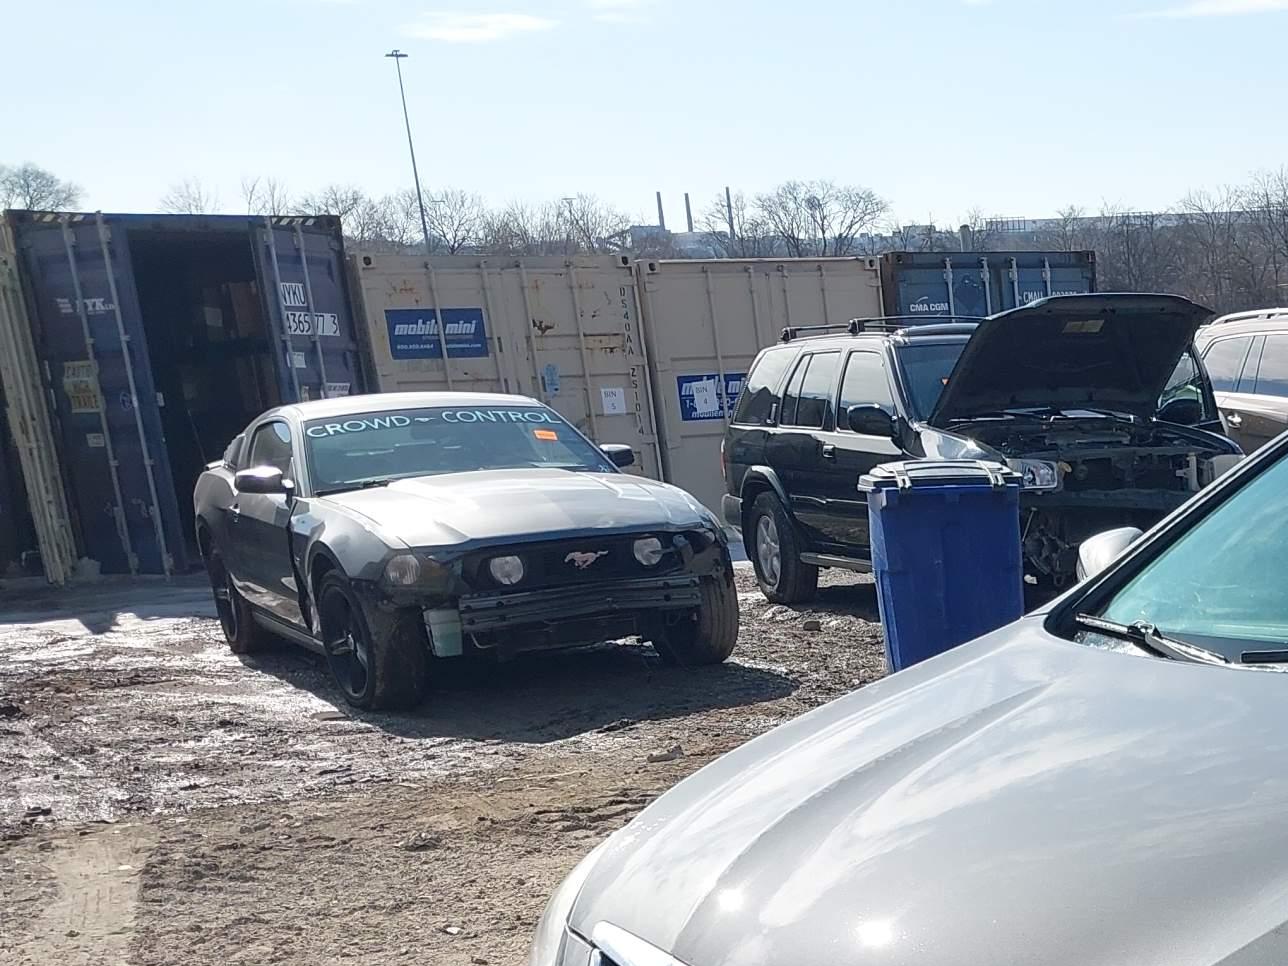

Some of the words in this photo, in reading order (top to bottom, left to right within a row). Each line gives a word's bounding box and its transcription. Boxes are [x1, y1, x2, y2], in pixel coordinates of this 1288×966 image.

[910, 303, 930, 312] CMA
[930, 303, 949, 311] CGM
[445, 320, 477, 334] mini
[306, 415, 410, 438] CROWD
[442, 410, 562, 424] CONTROL
